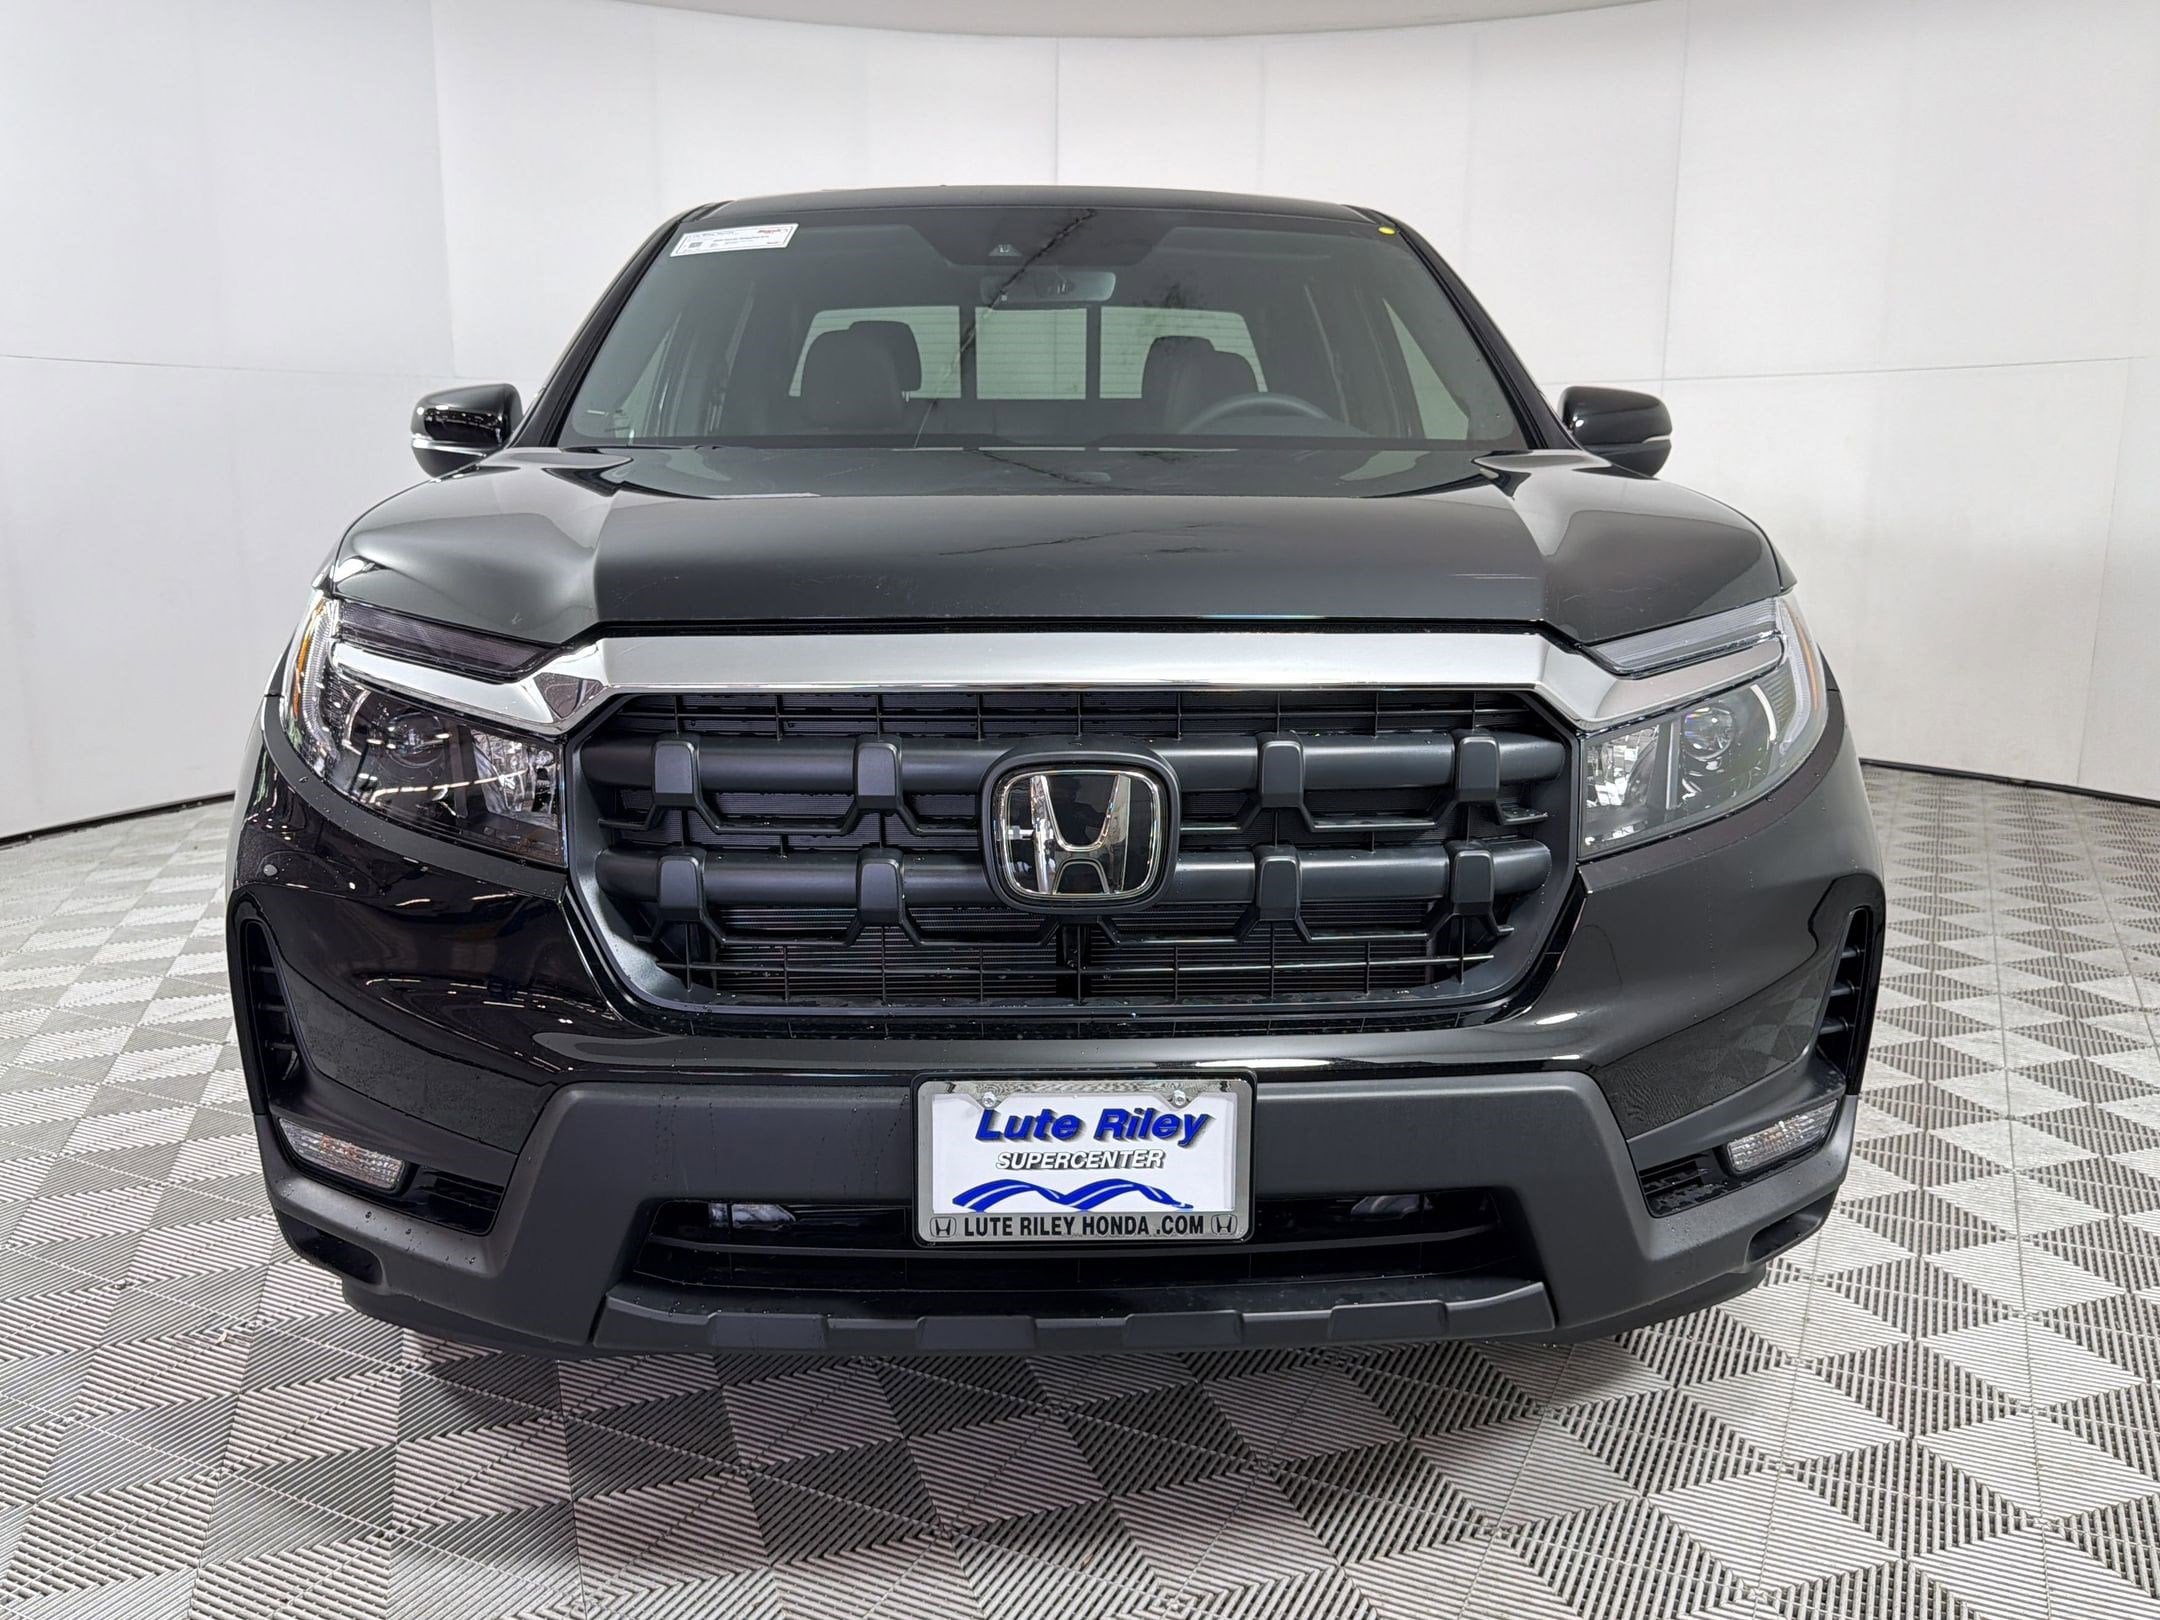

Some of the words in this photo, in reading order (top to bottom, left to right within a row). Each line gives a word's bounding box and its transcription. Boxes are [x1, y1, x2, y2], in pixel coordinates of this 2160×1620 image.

[975, 1107, 1082, 1142] Lute
[1093, 1107, 1210, 1147] Riley
[996, 1149, 1166, 1170] SUPERCENTER
[964, 1216, 1013, 1237] LUTE
[1020, 1216, 1075, 1237] RILEY
[1082, 1215, 1150, 1236] HONDA
